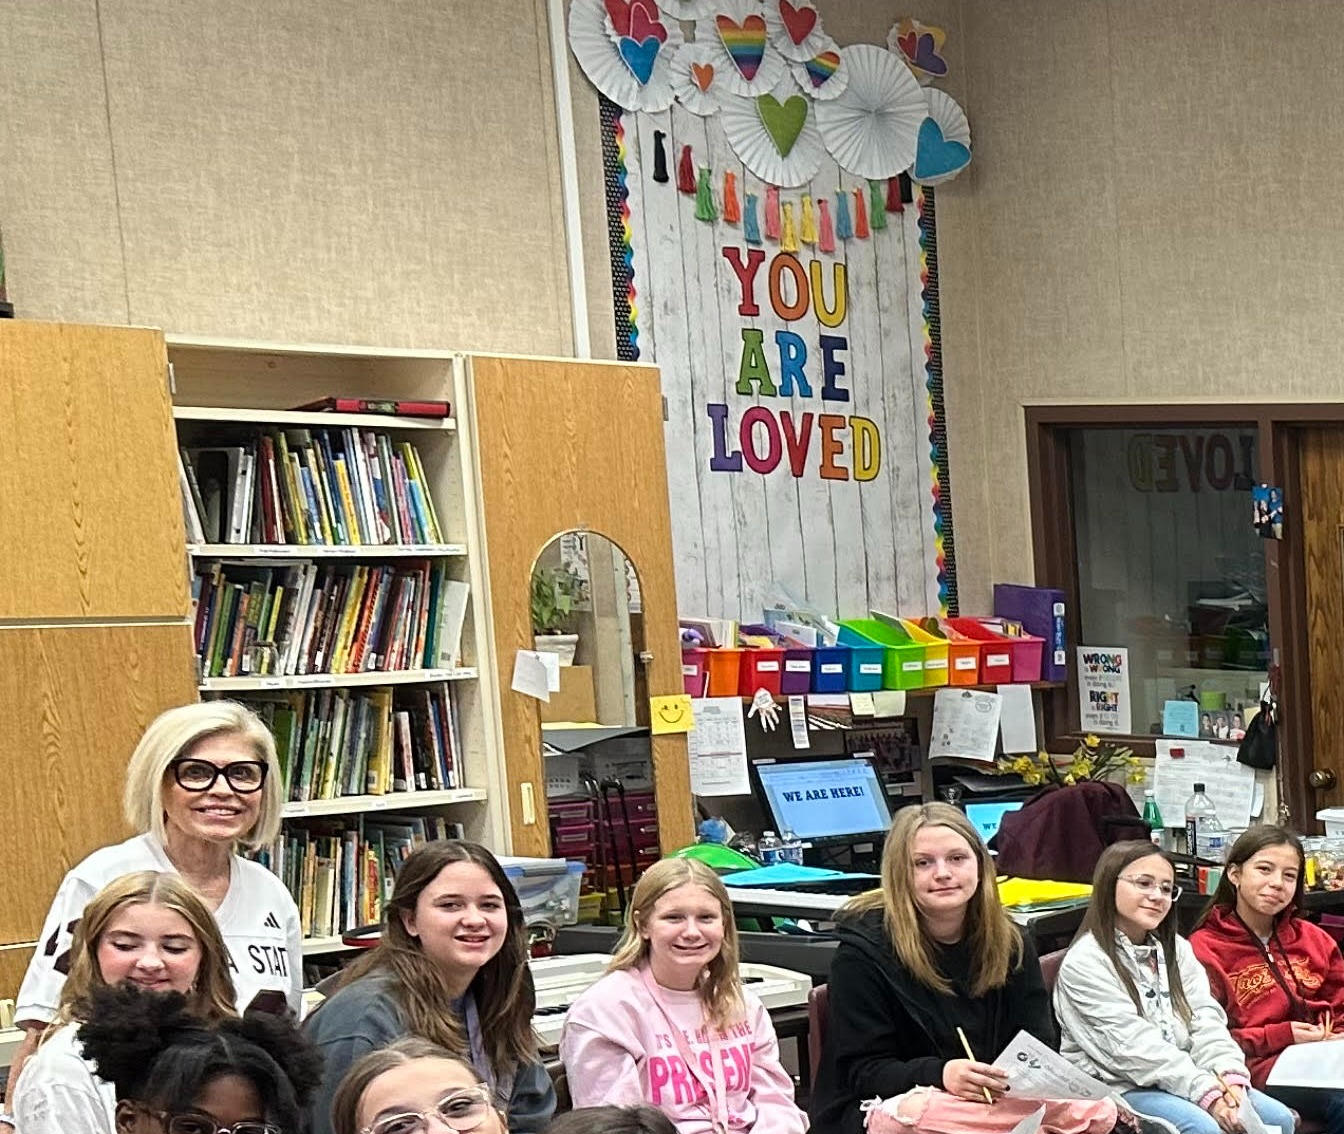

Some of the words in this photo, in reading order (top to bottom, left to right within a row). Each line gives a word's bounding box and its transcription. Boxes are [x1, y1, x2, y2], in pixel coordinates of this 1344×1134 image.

[723, 246, 848, 328] YOU
[736, 329, 849, 401] ARE
[707, 403, 881, 482] LOVED
[1083, 653, 1121, 666] WRONG
[782, 791, 803, 802] WE
[805, 789, 828, 801] ARE
[830, 786, 865, 799] HERE!
